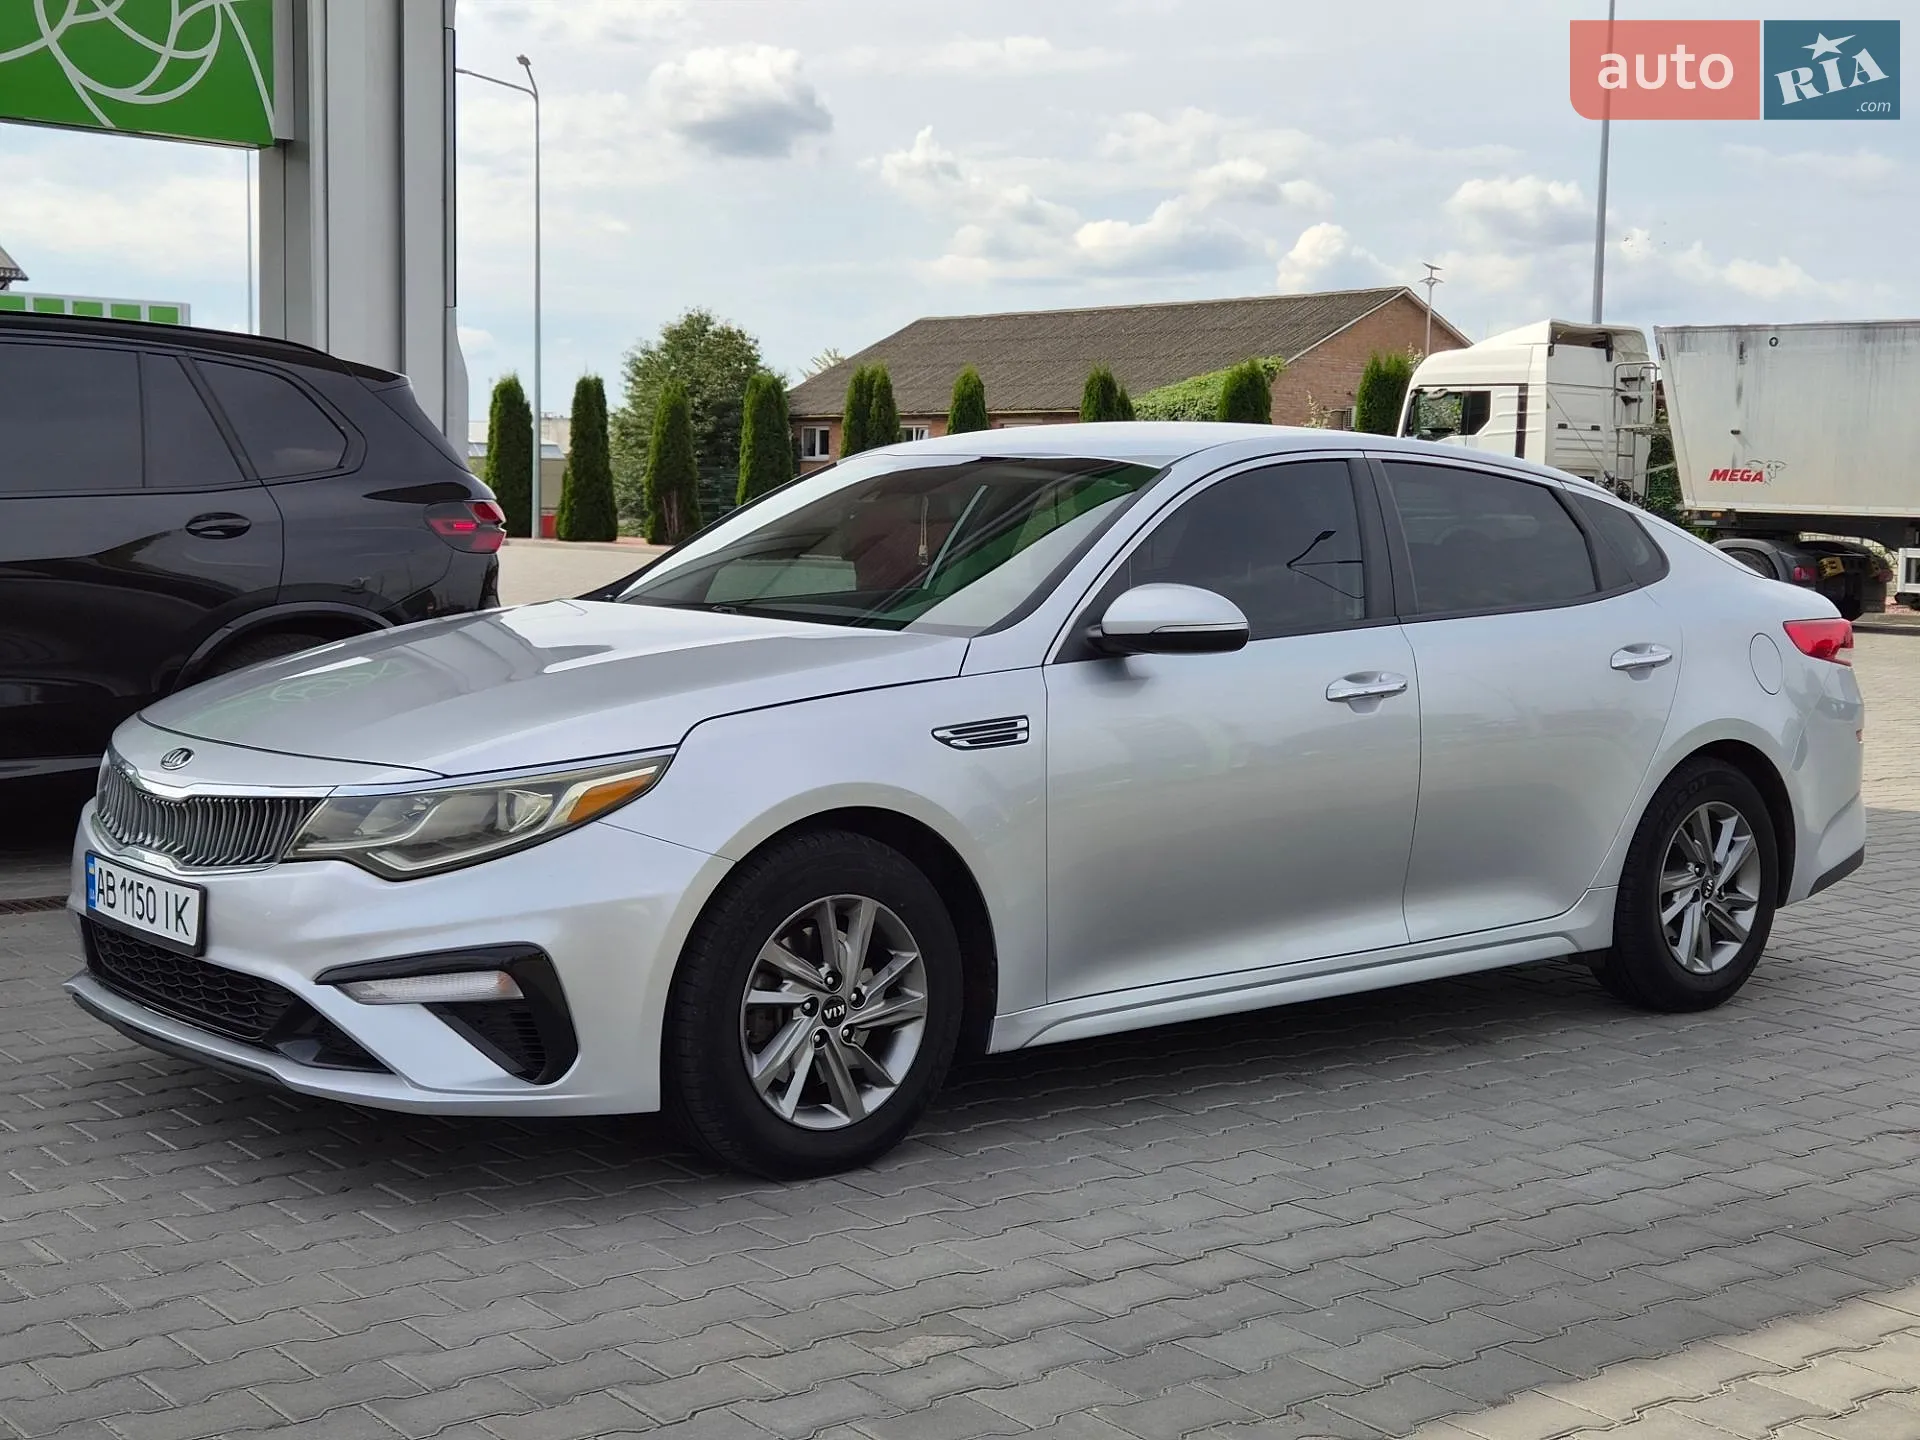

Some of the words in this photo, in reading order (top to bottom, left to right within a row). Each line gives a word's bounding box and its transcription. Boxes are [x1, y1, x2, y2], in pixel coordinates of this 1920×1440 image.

[1709, 469, 1764, 483] MEGA
[97, 867, 117, 909] AB
[120, 877, 156, 925] 1150
[165, 889, 190, 937] IK
[824, 1004, 846, 1019] KIA
